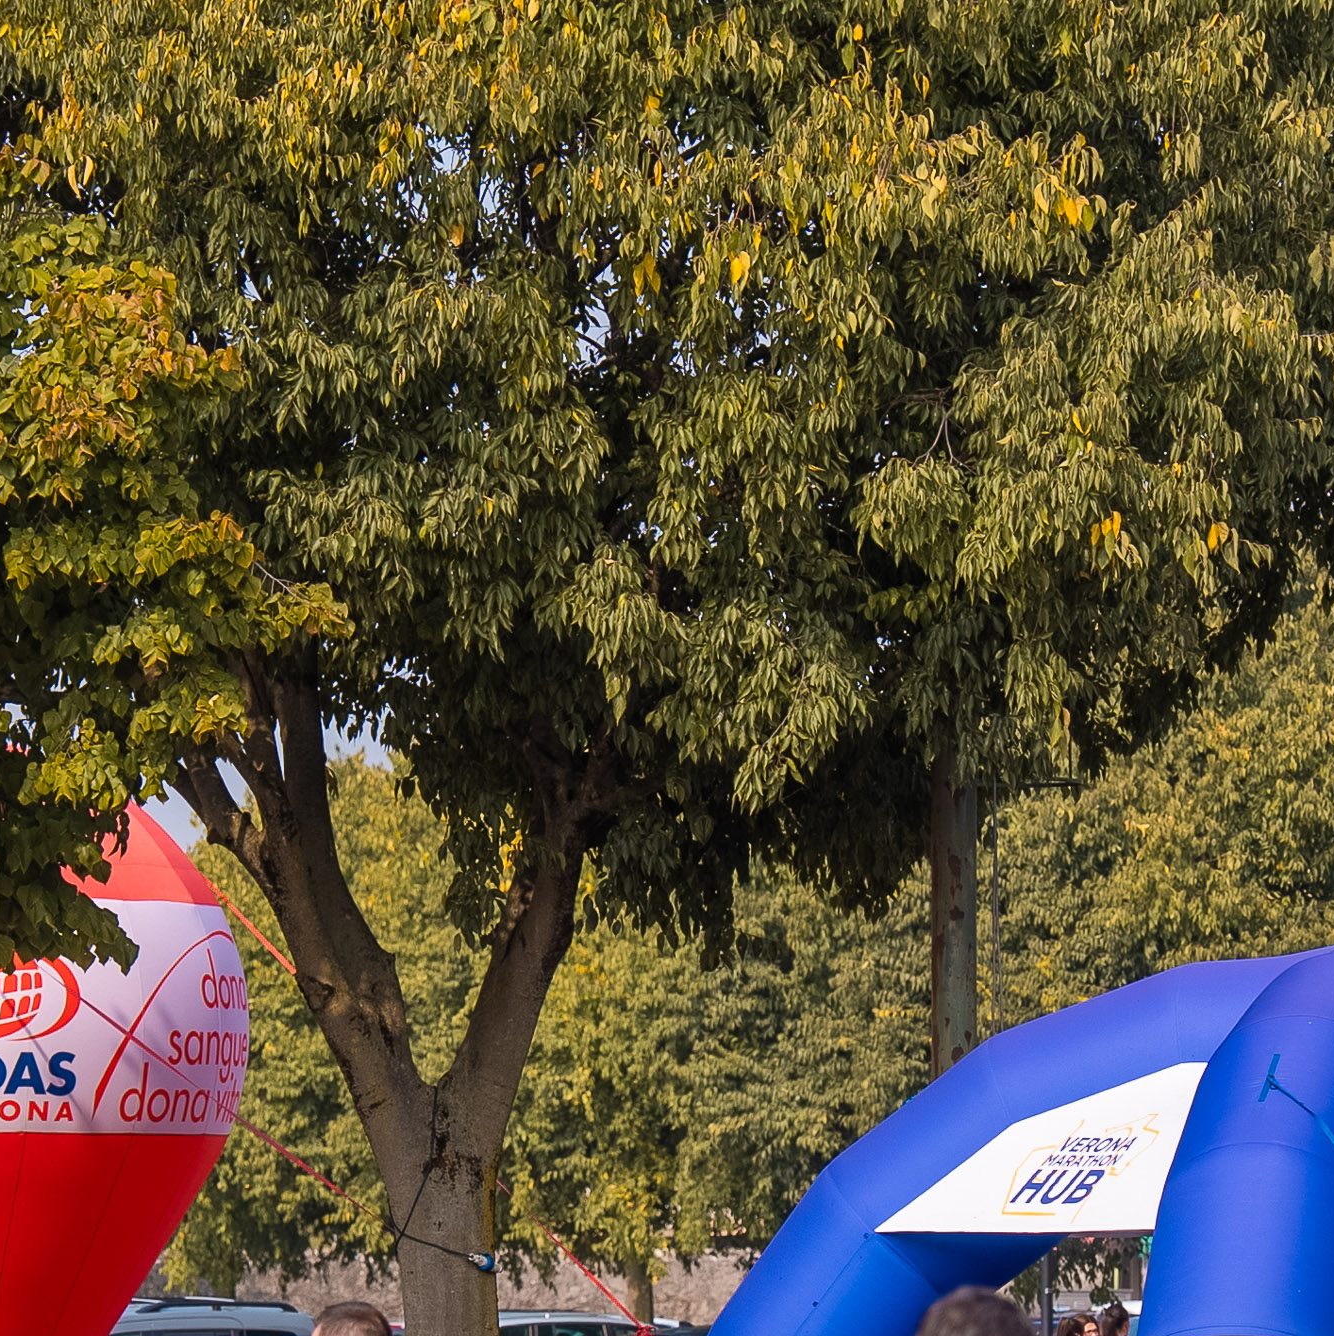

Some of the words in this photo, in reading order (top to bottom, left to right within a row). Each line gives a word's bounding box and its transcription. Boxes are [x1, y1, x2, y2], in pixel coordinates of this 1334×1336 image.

[167, 1029, 247, 1083] sangue
[119, 1062, 210, 1123] dona
[1041, 1154, 1123, 1167] MARATHON
[1060, 1136, 1138, 1152] VERONA
[1009, 1169, 1105, 1204] HUB
